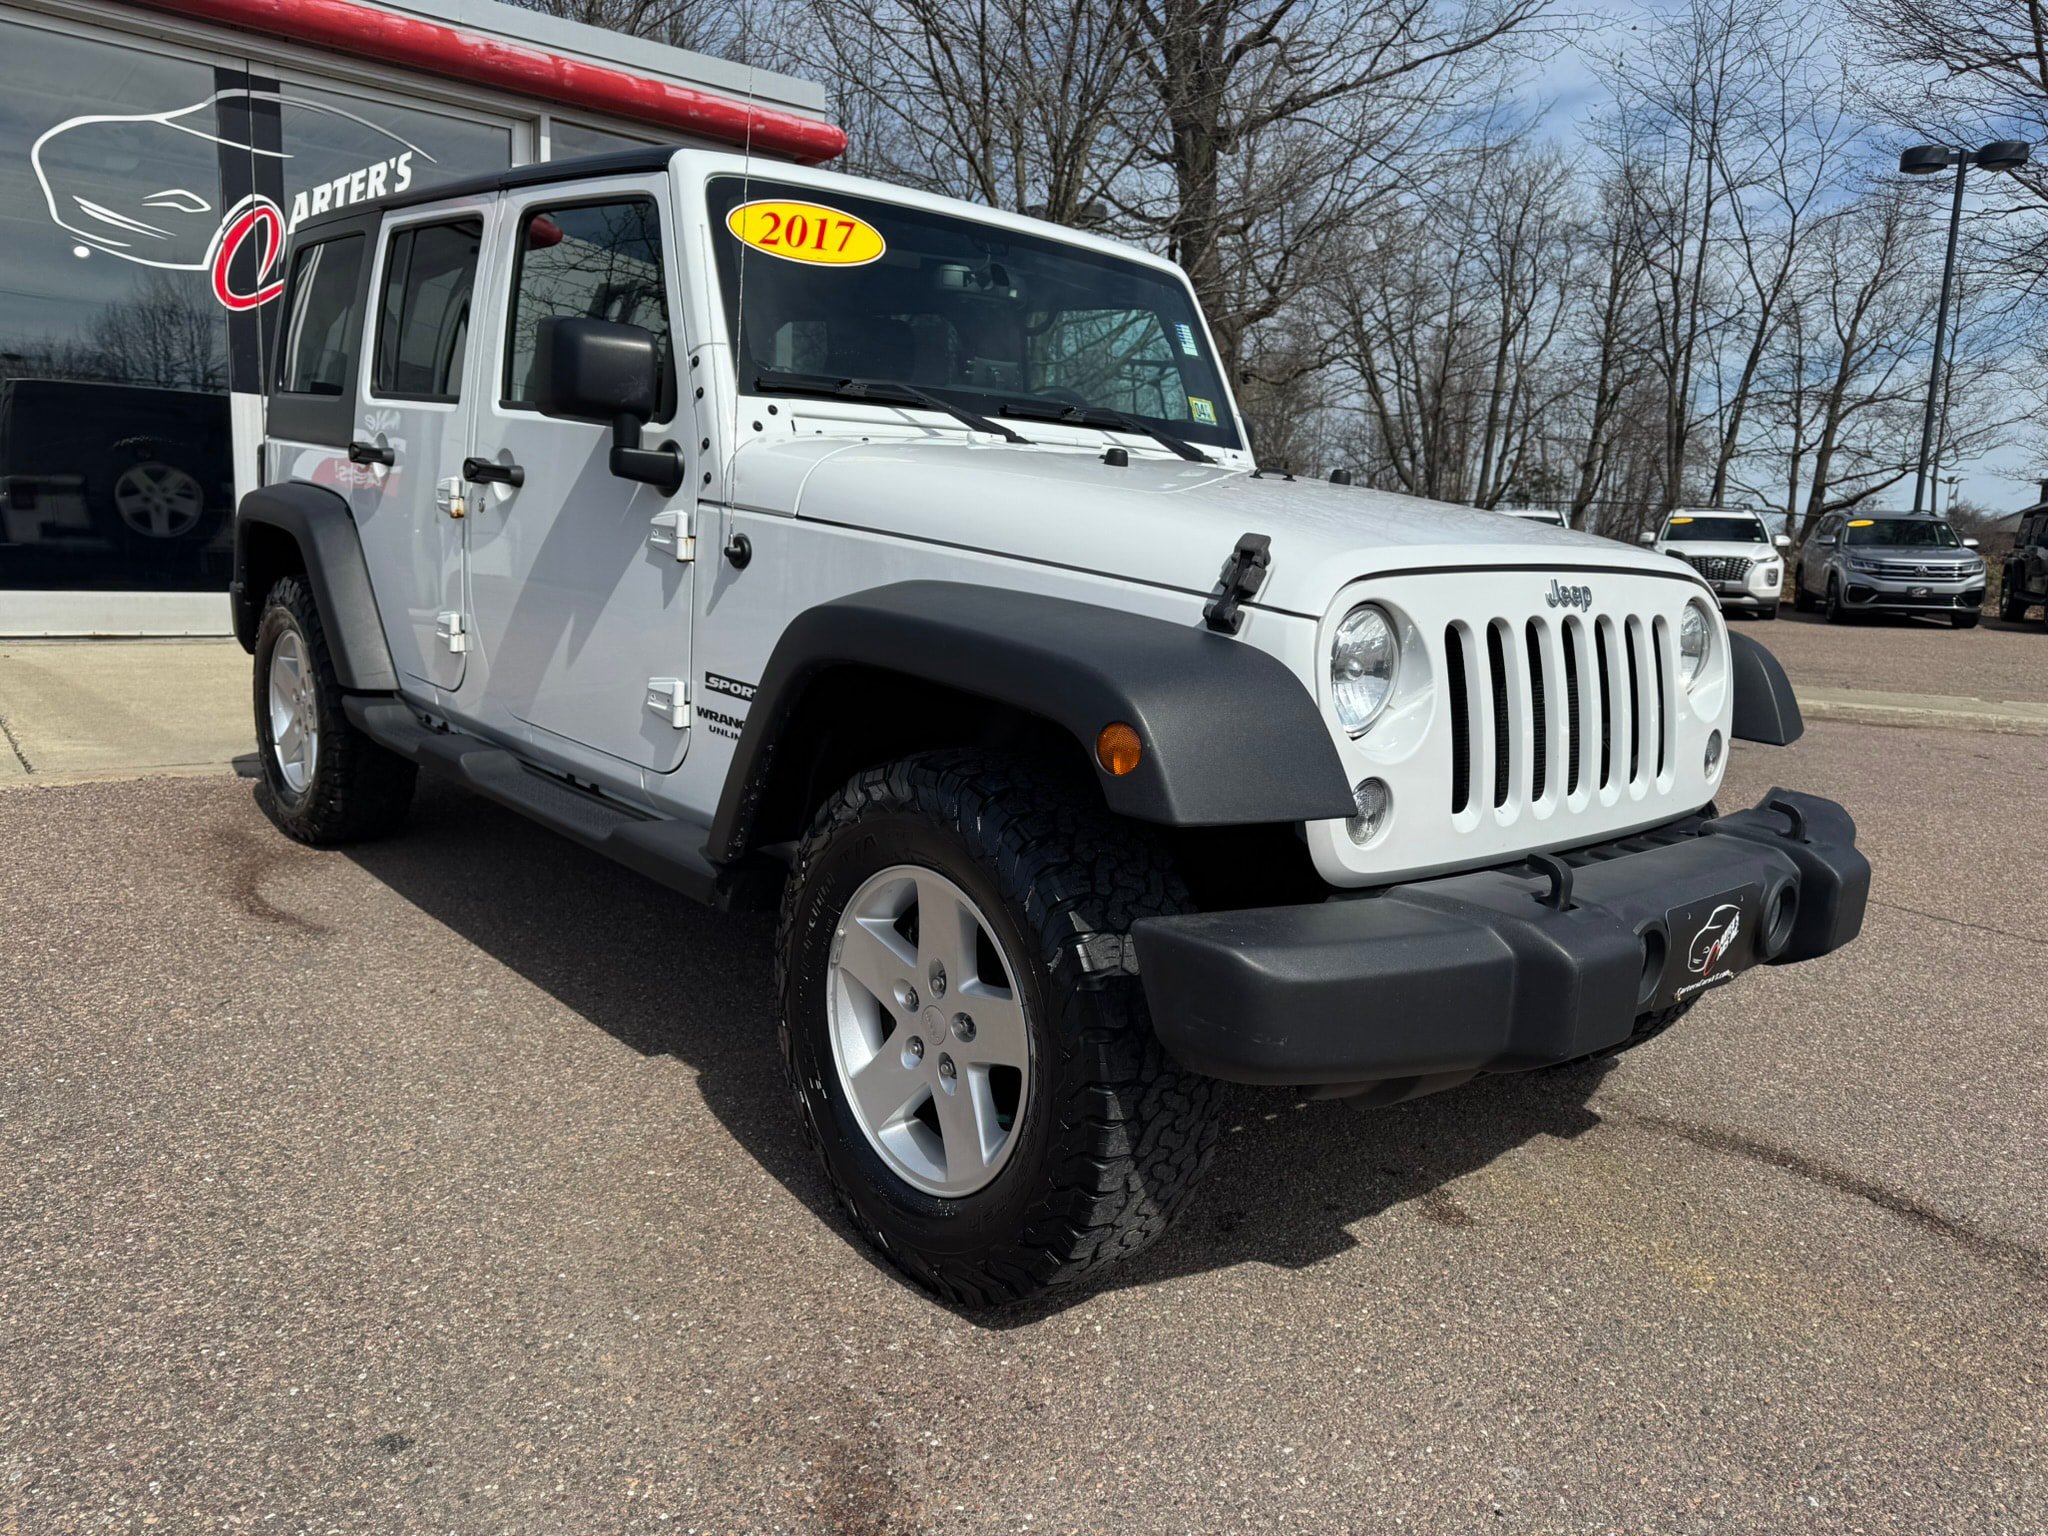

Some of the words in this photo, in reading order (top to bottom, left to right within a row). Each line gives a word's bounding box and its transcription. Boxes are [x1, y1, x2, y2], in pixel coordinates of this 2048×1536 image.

[758, 211, 856, 252] 2017
[1545, 579, 1592, 613] Jeep
[705, 676, 757, 698] SPOR
